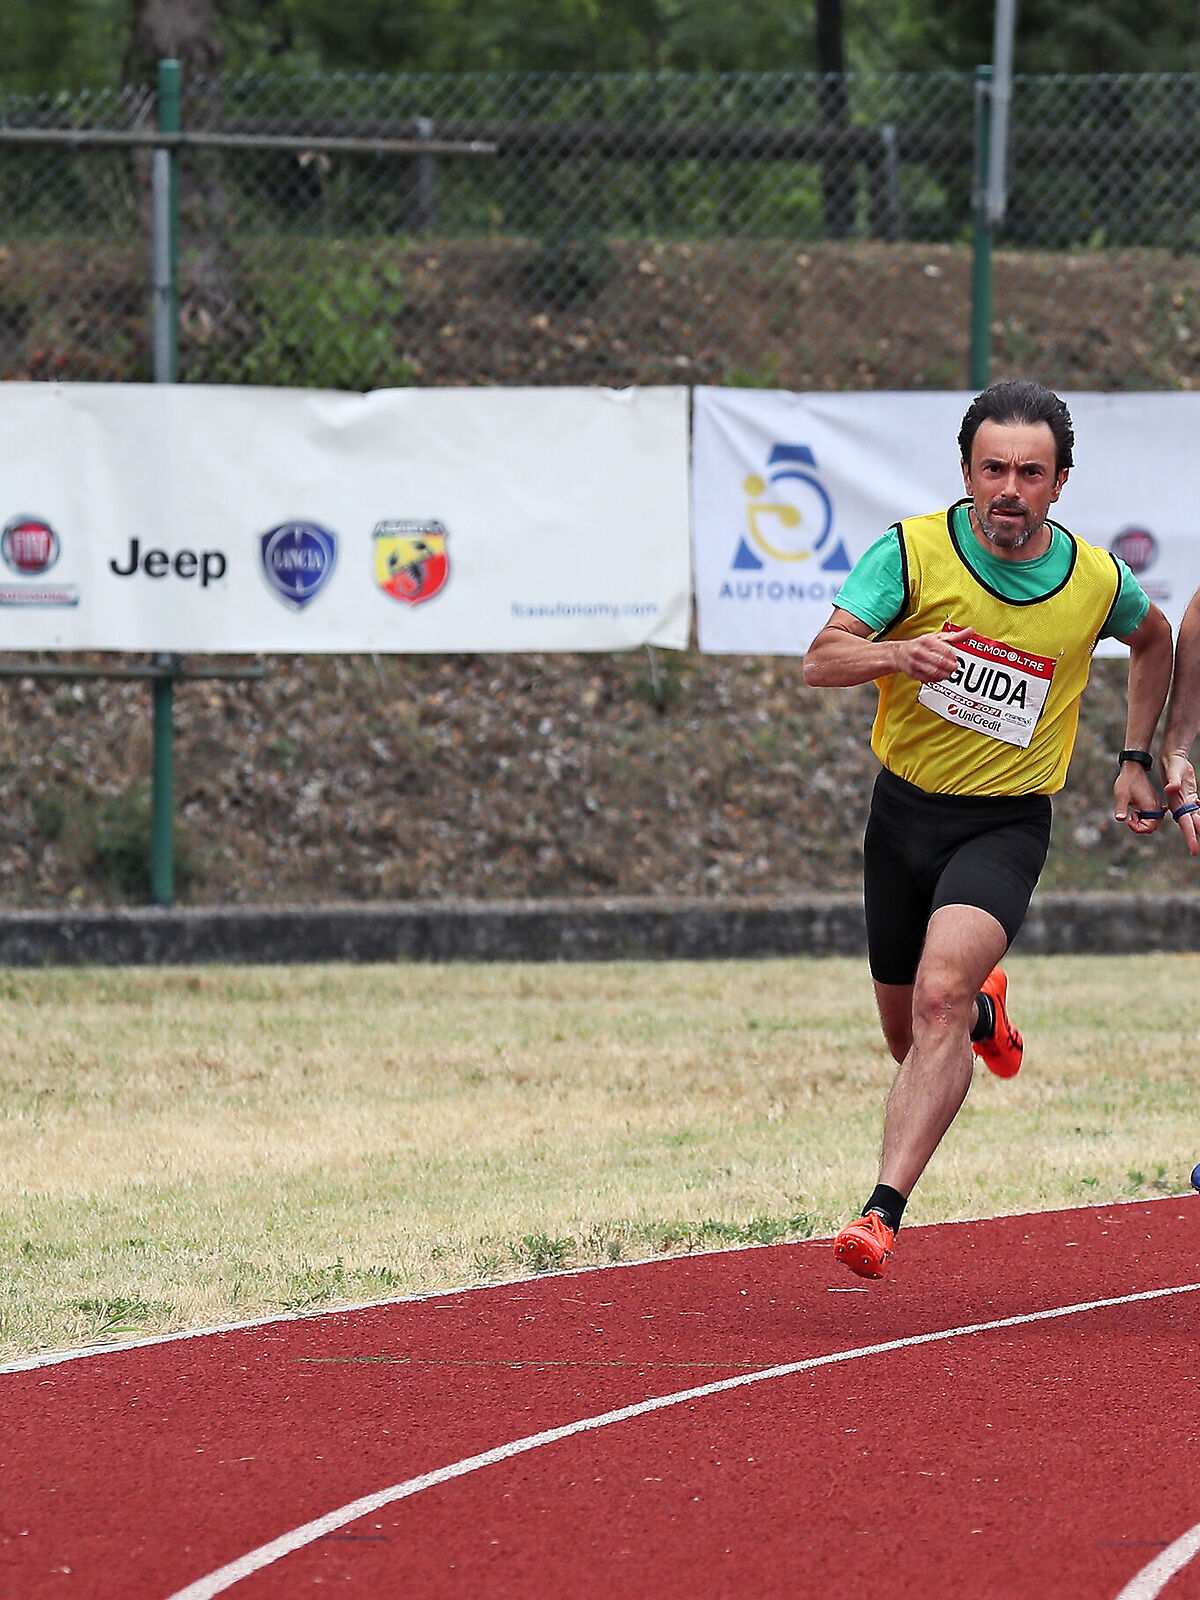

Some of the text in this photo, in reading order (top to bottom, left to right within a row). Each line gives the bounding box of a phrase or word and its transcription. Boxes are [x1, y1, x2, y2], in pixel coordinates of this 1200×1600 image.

[110, 539, 228, 588] Jeep
[272, 550, 322, 571] LANCIA
[719, 580, 842, 600] AUTONO
[949, 655, 1029, 710] GUIDA
[957, 708, 1002, 732] UniCredit
